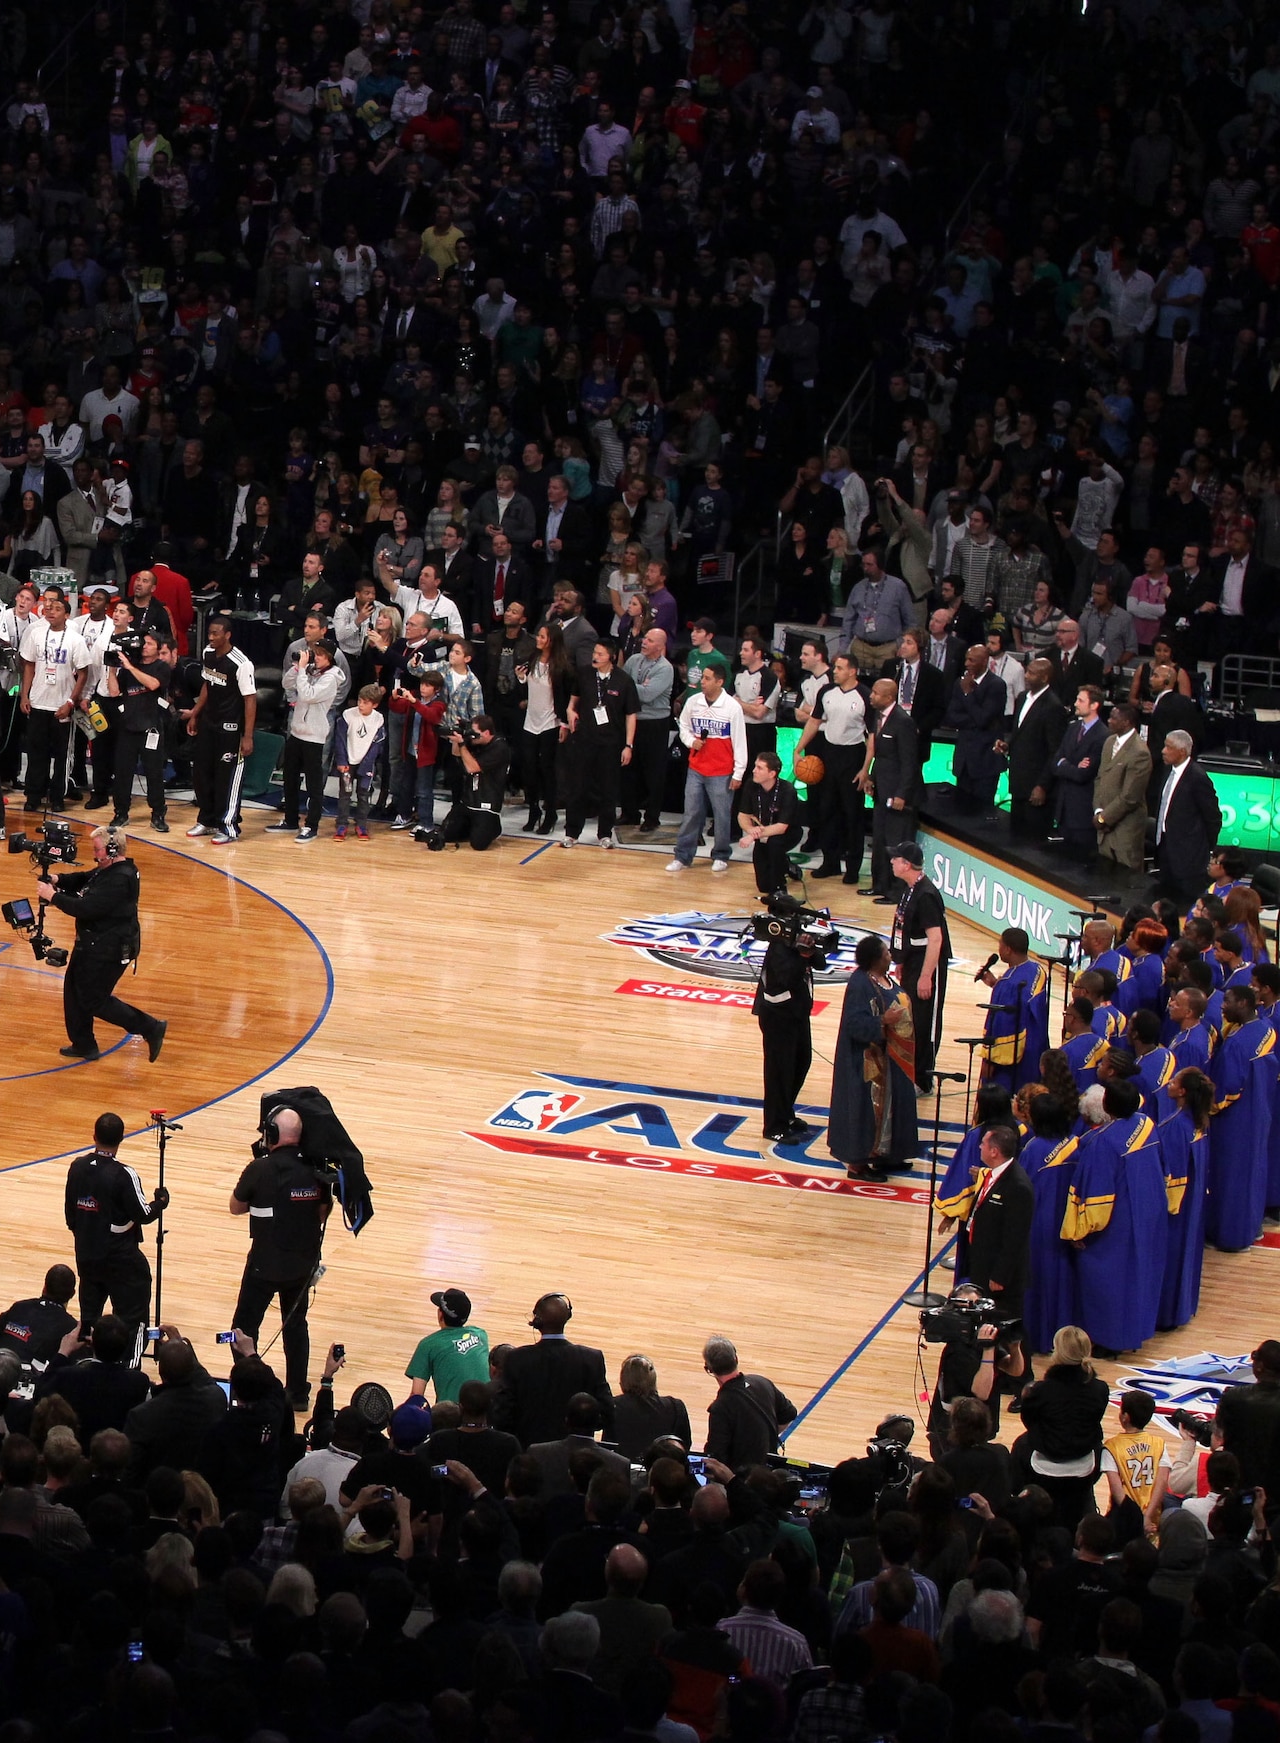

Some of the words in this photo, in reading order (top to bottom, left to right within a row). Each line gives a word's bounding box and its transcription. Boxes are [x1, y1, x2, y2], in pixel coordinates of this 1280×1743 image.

[932, 853, 987, 912] SLAM
[991, 881, 1054, 946] DUNK
[633, 983, 722, 1001] State
[721, 994, 755, 1006] Fa
[495, 1118, 531, 1128] NBA
[587, 1150, 717, 1174] LOS
[751, 1172, 937, 1202] ANGE
[457, 1334, 480, 1352] Sprite
[1126, 1442, 1152, 1456] BRYANT
[1127, 1456, 1154, 1488] 24
